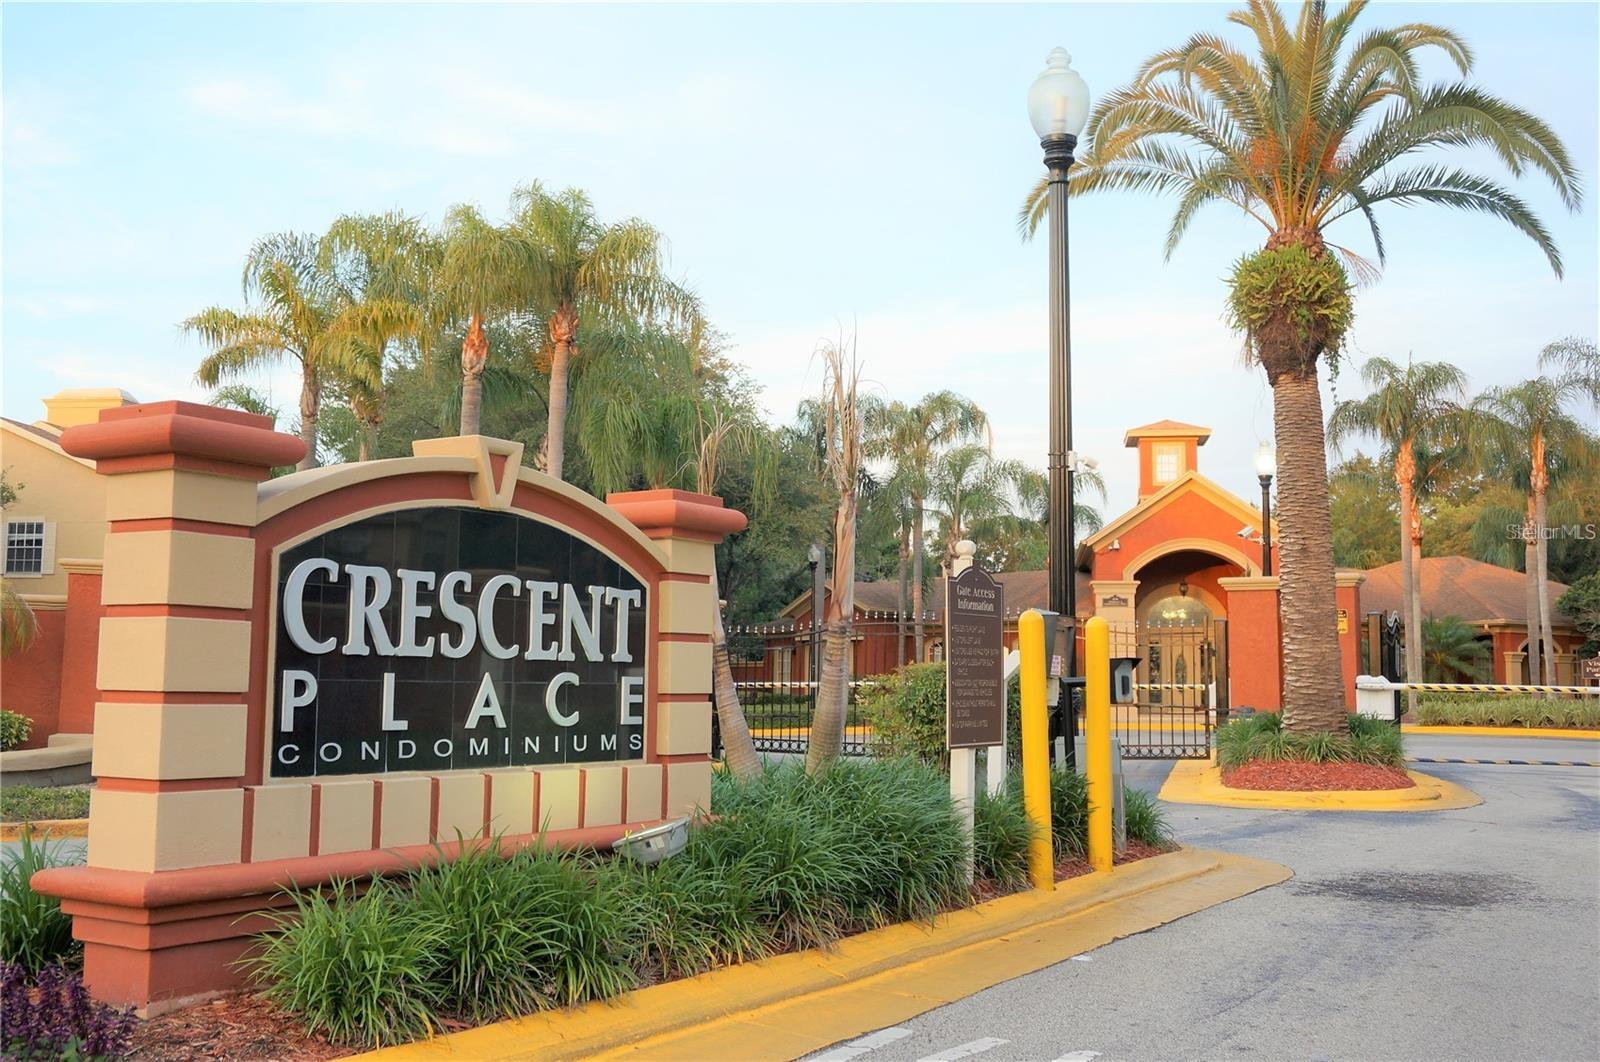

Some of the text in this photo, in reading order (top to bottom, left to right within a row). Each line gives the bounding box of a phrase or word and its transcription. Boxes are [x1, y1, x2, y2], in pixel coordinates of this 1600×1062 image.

[957, 585, 995, 599] Gate Access
[958, 599, 995, 612] Information
[283, 557, 641, 663] CRESCENT
[280, 669, 643, 732] PLACE
[278, 734, 643, 764] CONDOMINIUMS
